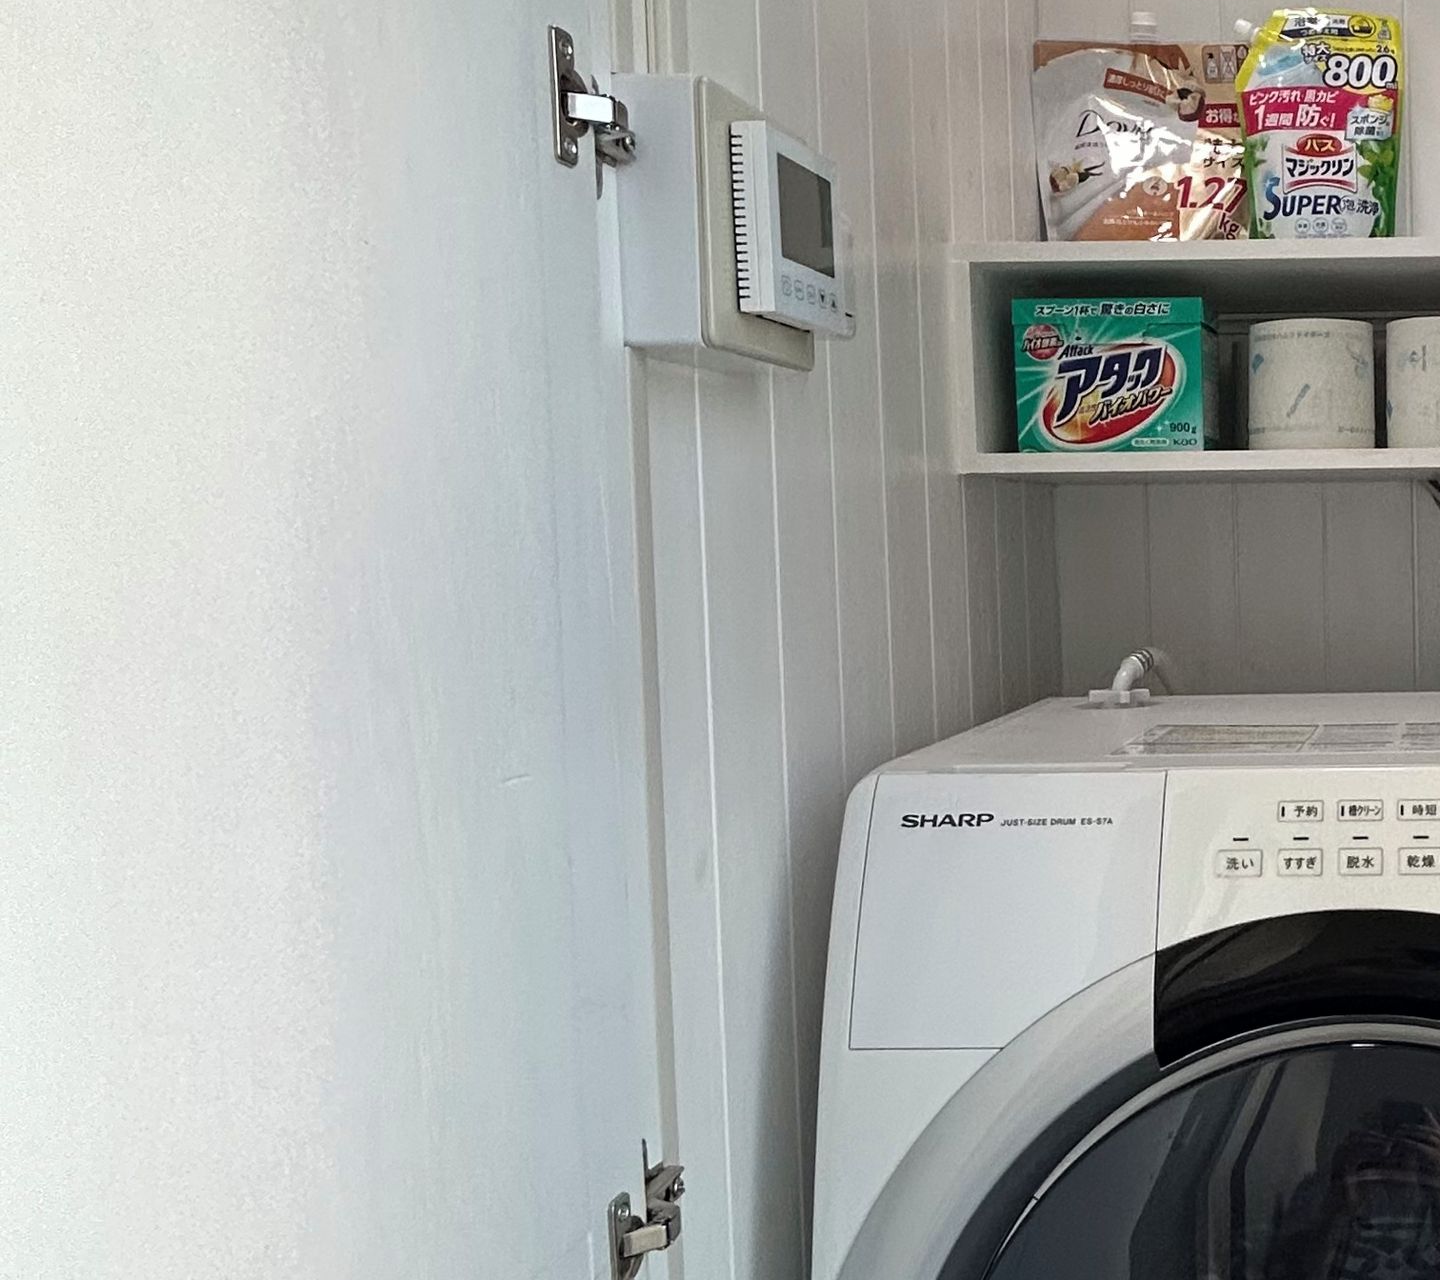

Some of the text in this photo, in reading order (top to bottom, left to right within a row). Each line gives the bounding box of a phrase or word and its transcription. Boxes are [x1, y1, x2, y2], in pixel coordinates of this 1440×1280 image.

[1205, 108, 1239, 123] お得
[1285, 158, 1354, 178] マジックリン
[1176, 176, 1249, 214] 1.27
[1263, 176, 1342, 221] SUPER
[1219, 213, 1239, 240] kg
[1058, 345, 1094, 361] Attack
[1055, 347, 1163, 425] アタック
[1088, 385, 1173, 424] バイオパワー
[1294, 805, 1318, 817] 予約
[1412, 804, 1437, 816] 時短
[901, 813, 995, 828] SHARP
[1050, 817, 1076, 825] DRUM
[1226, 856, 1255, 870] 洗い
[1283, 856, 1318, 870] すすぎ
[1346, 855, 1375, 869] 脱水
[1407, 854, 1436, 868] 乾燥
